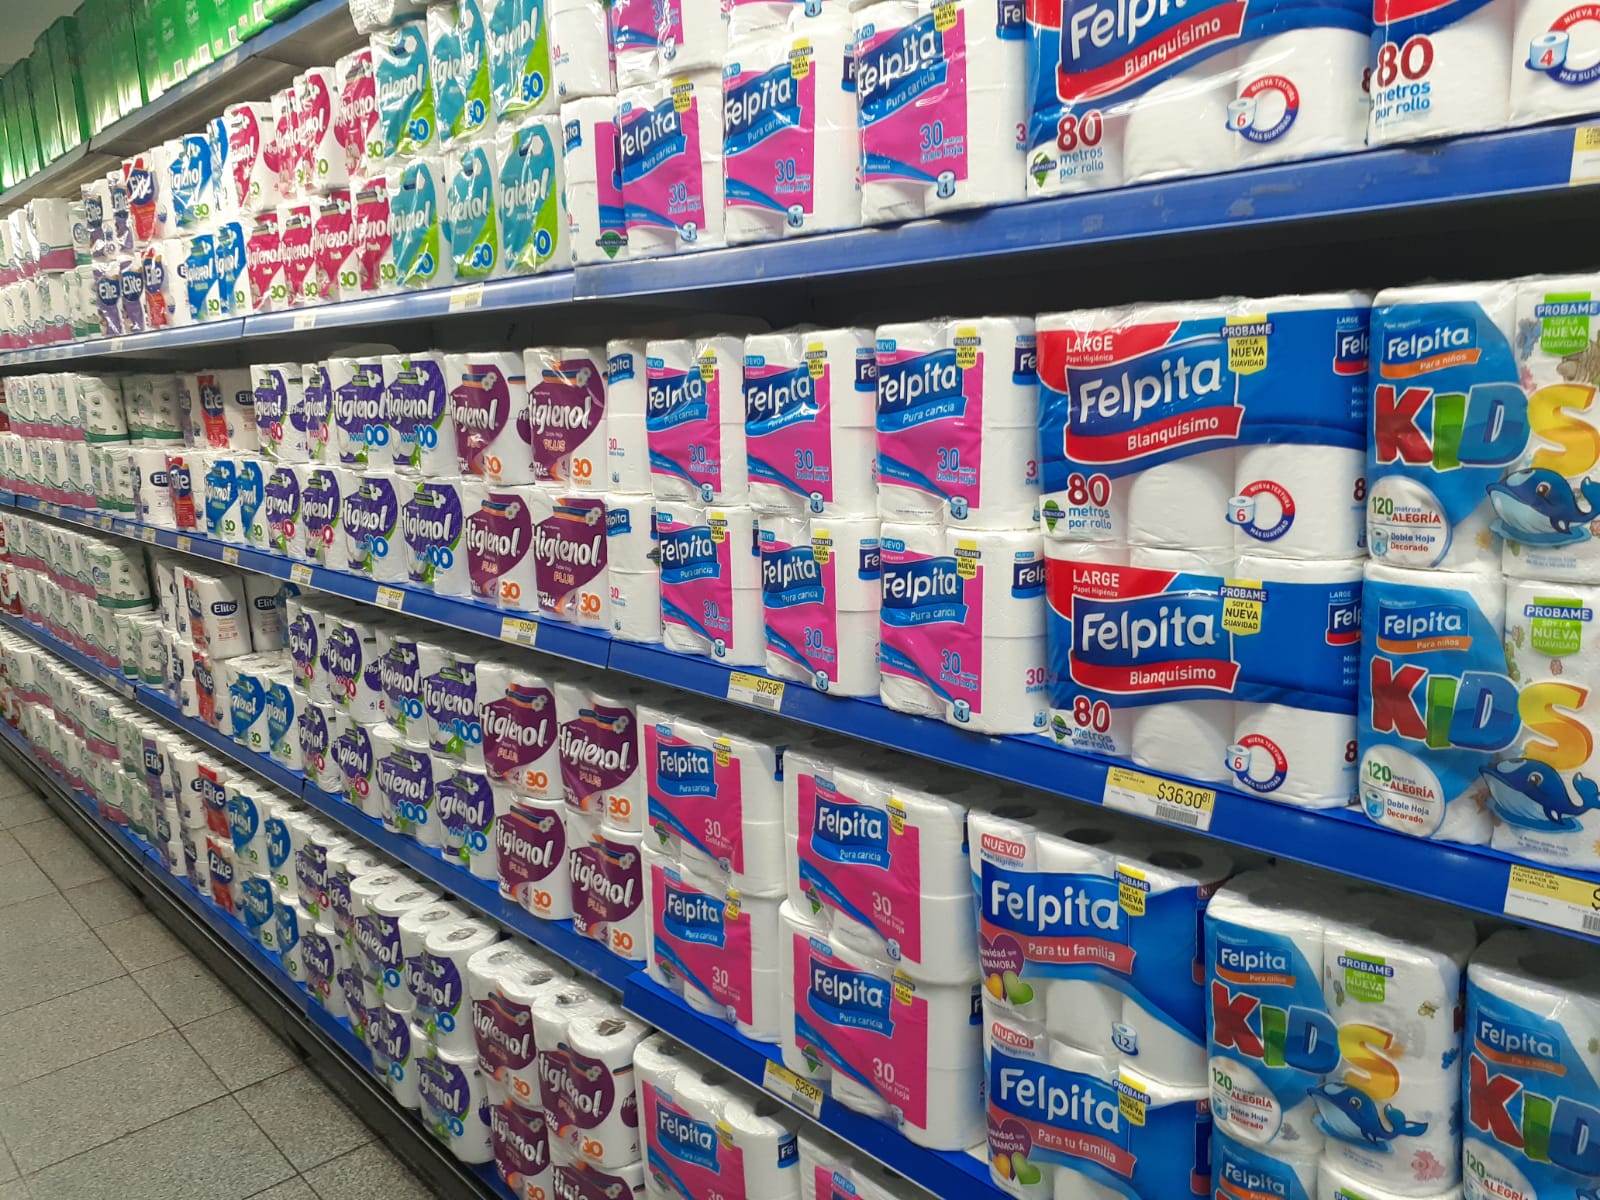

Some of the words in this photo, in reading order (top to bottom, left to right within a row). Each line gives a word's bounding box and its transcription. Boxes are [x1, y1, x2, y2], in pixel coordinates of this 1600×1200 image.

[1124, 17, 1221, 76] Blanquísimo
[1377, 38, 1433, 87] 80
[1540, 49, 1553, 66] 4
[886, 91, 906, 110] Pura
[909, 72, 935, 95] caricia
[1376, 82, 1430, 105] metros
[1375, 106, 1391, 121] por
[1396, 98, 1430, 114] rollo
[1057, 109, 1103, 151] 80
[1237, 113, 1245, 128] 6
[920, 122, 943, 150] 30
[1060, 147, 1103, 164] metros
[774, 158, 794, 184] 30
[1060, 166, 1078, 178] por
[1080, 160, 1104, 173] rollo
[669, 183, 686, 205] 30
[340, 273, 357, 287] 30
[271, 285, 286, 299] 30
[1537, 303, 1596, 316] PROBAME
[1222, 323, 1272, 336] PROBAME
[1337, 317, 1358, 325] LARGE
[1543, 326, 1587, 338] NUEVA
[1067, 336, 1113, 352] LARGE
[1231, 345, 1265, 356] NUEVA
[1387, 327, 1471, 361] Felpita
[1230, 359, 1264, 367] SUAVIDAD
[878, 371, 955, 405] Felpita
[1080, 356, 1221, 423] Felpita
[529, 390, 591, 434] Higienol
[903, 410, 923, 423] Pura
[925, 404, 954, 418] caricia
[1128, 418, 1219, 451] Blanquísimo
[1374, 383, 1599, 479] KIDS
[689, 446, 705, 463] 30
[795, 450, 814, 470] 30
[938, 449, 959, 468] 30
[573, 458, 592, 477] 30
[1068, 473, 1110, 506] 80
[1069, 507, 1110, 518] metros
[1237, 509, 1246, 522] 6
[1372, 497, 1393, 516] 120
[1069, 519, 1084, 529] por
[1089, 519, 1111, 529] rollo
[1391, 514, 1440, 524] ALEGRÍA
[466, 519, 520, 556] Higienol
[533, 524, 601, 567] Higienol
[1390, 542, 1428, 552] Decorado
[1416, 534, 1436, 542] Hoja
[660, 534, 713, 563] Felpita
[764, 559, 816, 586] Felpita
[1072, 569, 1119, 587] LARGE
[502, 583, 520, 599] 30
[883, 571, 956, 603] Felpita
[1073, 586, 1091, 594] Papel
[1221, 587, 1267, 600] PROBAME
[212, 602, 238, 612] Elite
[581, 594, 600, 613] 30
[703, 601, 718, 619] 30
[1245, 601, 1254, 609] LA
[1527, 606, 1590, 619] PROBAME
[910, 609, 930, 621] Pura
[932, 609, 955, 618] caricia
[1225, 608, 1258, 620] NUEVA
[1082, 607, 1216, 659] Felpita
[1223, 621, 1258, 630] SUAVIDAD
[1384, 612, 1461, 638] Felpita
[1534, 628, 1578, 639] NUEVA
[804, 629, 822, 648] 30
[1416, 640, 1435, 649] Para
[941, 650, 963, 675] 30
[1130, 666, 1216, 684] Blanquísimo
[757, 679, 783, 695] $1758
[1073, 696, 1111, 733] 80
[1371, 655, 1593, 771] KIDS
[480, 703, 547, 746] Higienol
[559, 727, 630, 771] Higienol
[660, 751, 709, 775] Felpita
[1367, 760, 1391, 782] 120
[526, 771, 547, 789] 30
[679, 783, 692, 792] Pura
[1390, 780, 1434, 799] ALEGRÍA
[609, 796, 631, 816] 30
[1387, 799, 1409, 812] Doble
[1411, 802, 1429, 815] Hoja
[819, 808, 881, 840] Felpita
[1387, 809, 1423, 823] Decorado
[704, 819, 721, 836] 30
[840, 850, 853, 858] Pura
[855, 852, 881, 861] caricia
[984, 837, 1024, 858] NUEVO!
[569, 852, 634, 907] Higienol
[1116, 871, 1149, 891] PROBAME
[533, 889, 552, 908] 30
[872, 892, 892, 916] 30
[991, 880, 1119, 931] Felpita
[1120, 892, 1143, 905] NUEVA
[667, 894, 719, 923] Felpita
[612, 929, 632, 950] 30
[1028, 943, 1054, 956] Para
[1058, 945, 1074, 955] tu
[1075, 945, 1115, 958] familia
[1221, 947, 1286, 972] Felpita
[1340, 956, 1392, 976] PROBAME
[712, 967, 728, 988] 30
[814, 971, 883, 1008] Felpita
[839, 1013, 855, 1023] Pura
[857, 1017, 882, 1029] caricia
[994, 1024, 1034, 1047] NUEVO!
[1118, 1035, 1130, 1048] 12
[1212, 979, 1400, 1100] KIDS
[1481, 1021, 1553, 1058] Felpita
[872, 1058, 894, 1084] 30
[1212, 1067, 1232, 1091] 120
[1000, 1067, 1119, 1133] Felpita
[1113, 1081, 1150, 1103] PROBAME
[1231, 1092, 1272, 1109] ALEGRÍA
[660, 1111, 712, 1151] Felpita
[1038, 1129, 1063, 1143] Para
[1065, 1139, 1076, 1149] tu
[1079, 1138, 1116, 1162] familia
[1225, 1160, 1285, 1193] Felpita
